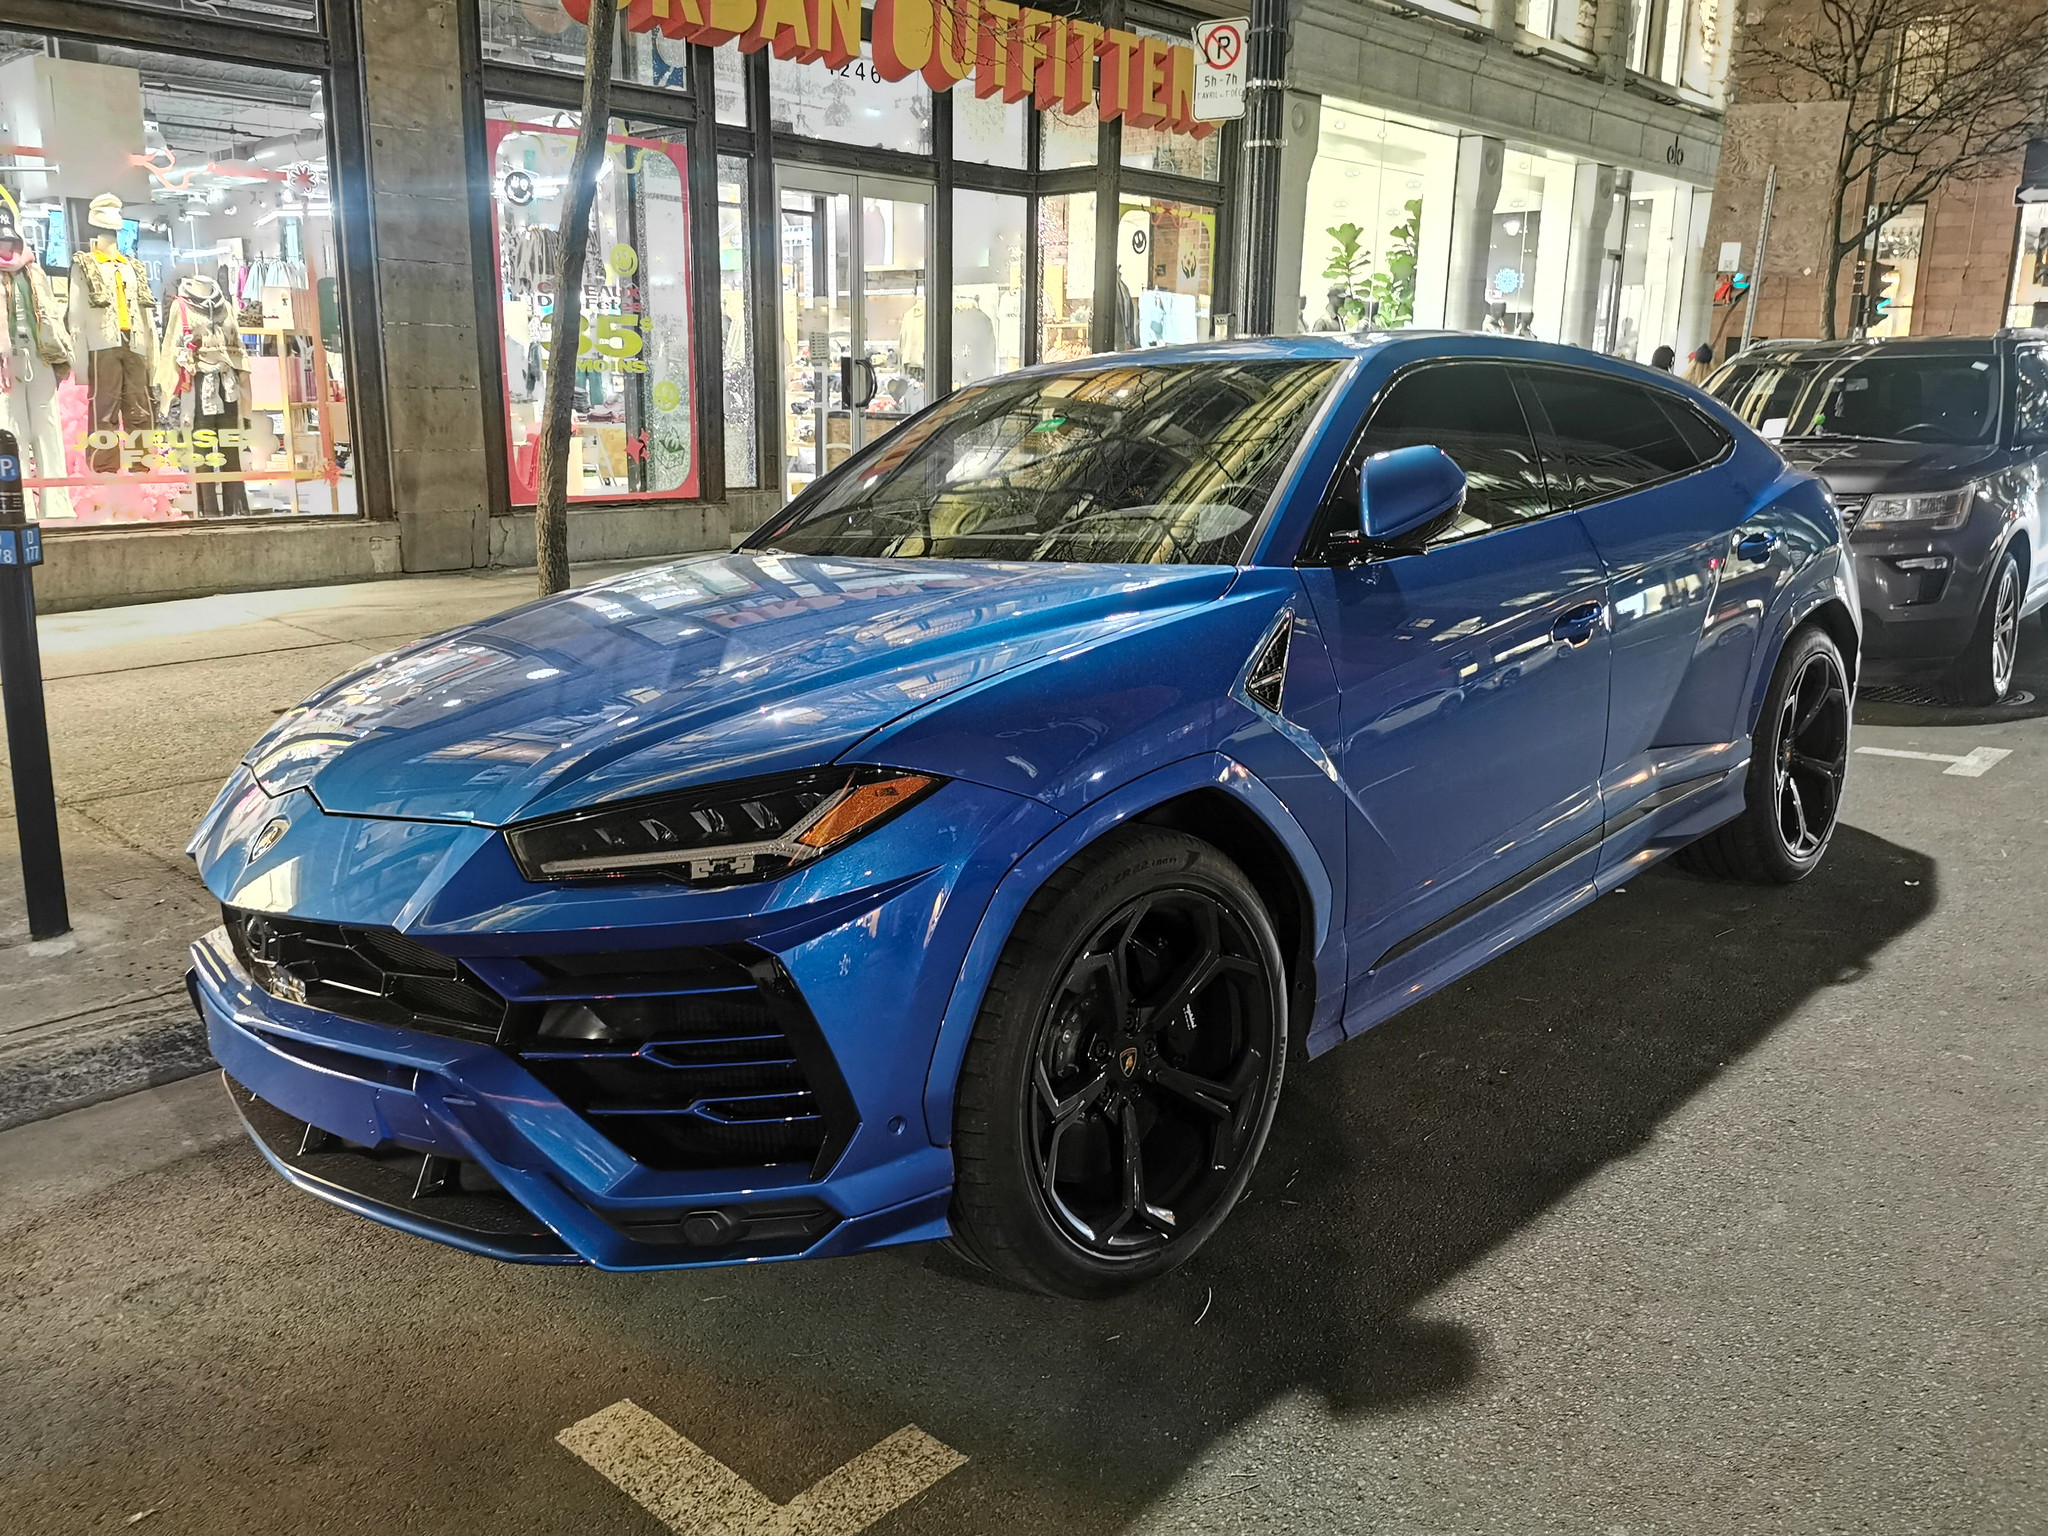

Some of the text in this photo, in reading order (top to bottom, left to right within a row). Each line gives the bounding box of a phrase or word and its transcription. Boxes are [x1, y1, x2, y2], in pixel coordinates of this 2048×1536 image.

[873, 0, 1226, 141] OUTFITTER
[1204, 76, 1217, 87] 5h
[1226, 74, 1238, 86] 7h
[537, 281, 641, 299] CEAUX
[577, 359, 647, 373] MOINS
